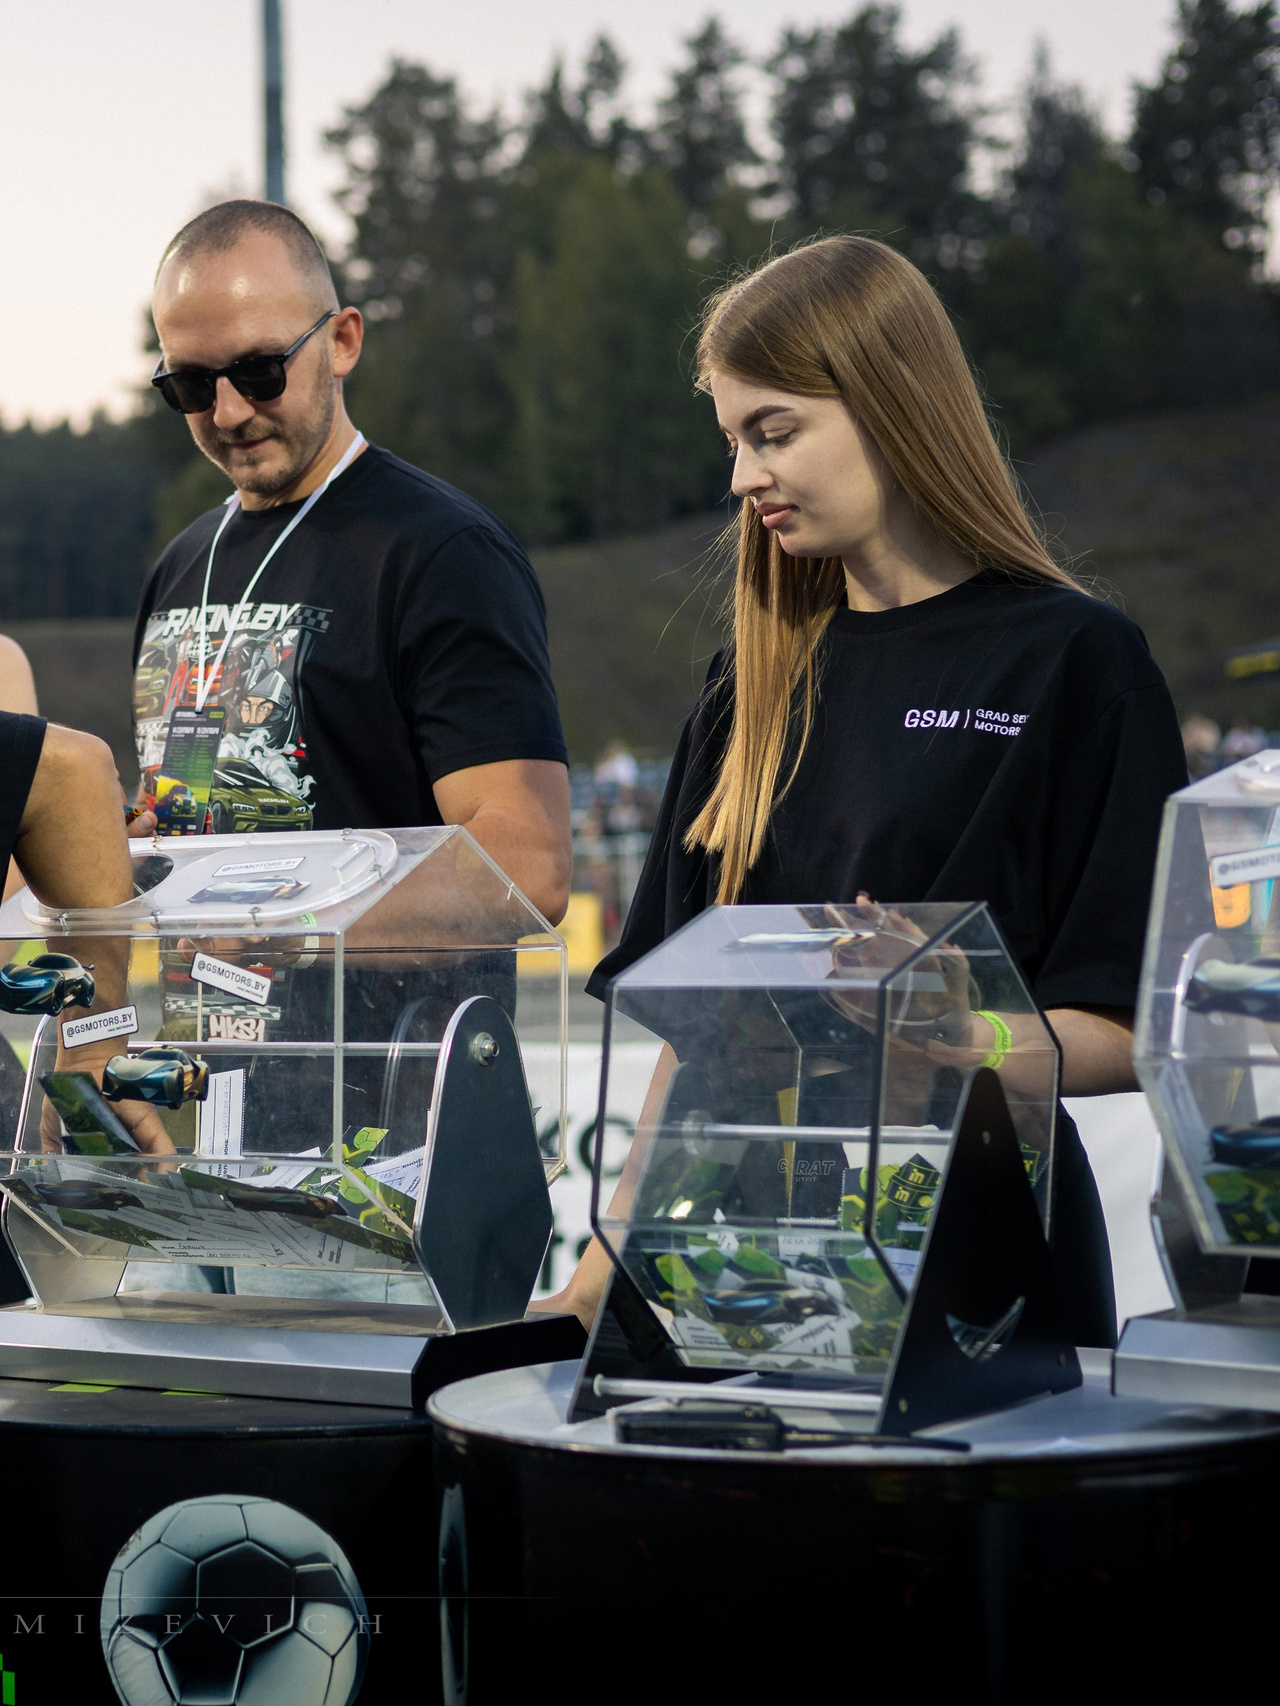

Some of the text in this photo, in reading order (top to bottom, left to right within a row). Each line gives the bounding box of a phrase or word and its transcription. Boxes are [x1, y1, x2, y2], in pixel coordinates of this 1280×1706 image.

[904, 709, 960, 728] GSM
[975, 708, 1010, 723] GRAD
[197, 960, 266, 991] @GSMOTORS.BY
[66, 1013, 133, 1037] @GSMOTORS.BY
[777, 1158, 836, 1176] CRAT
